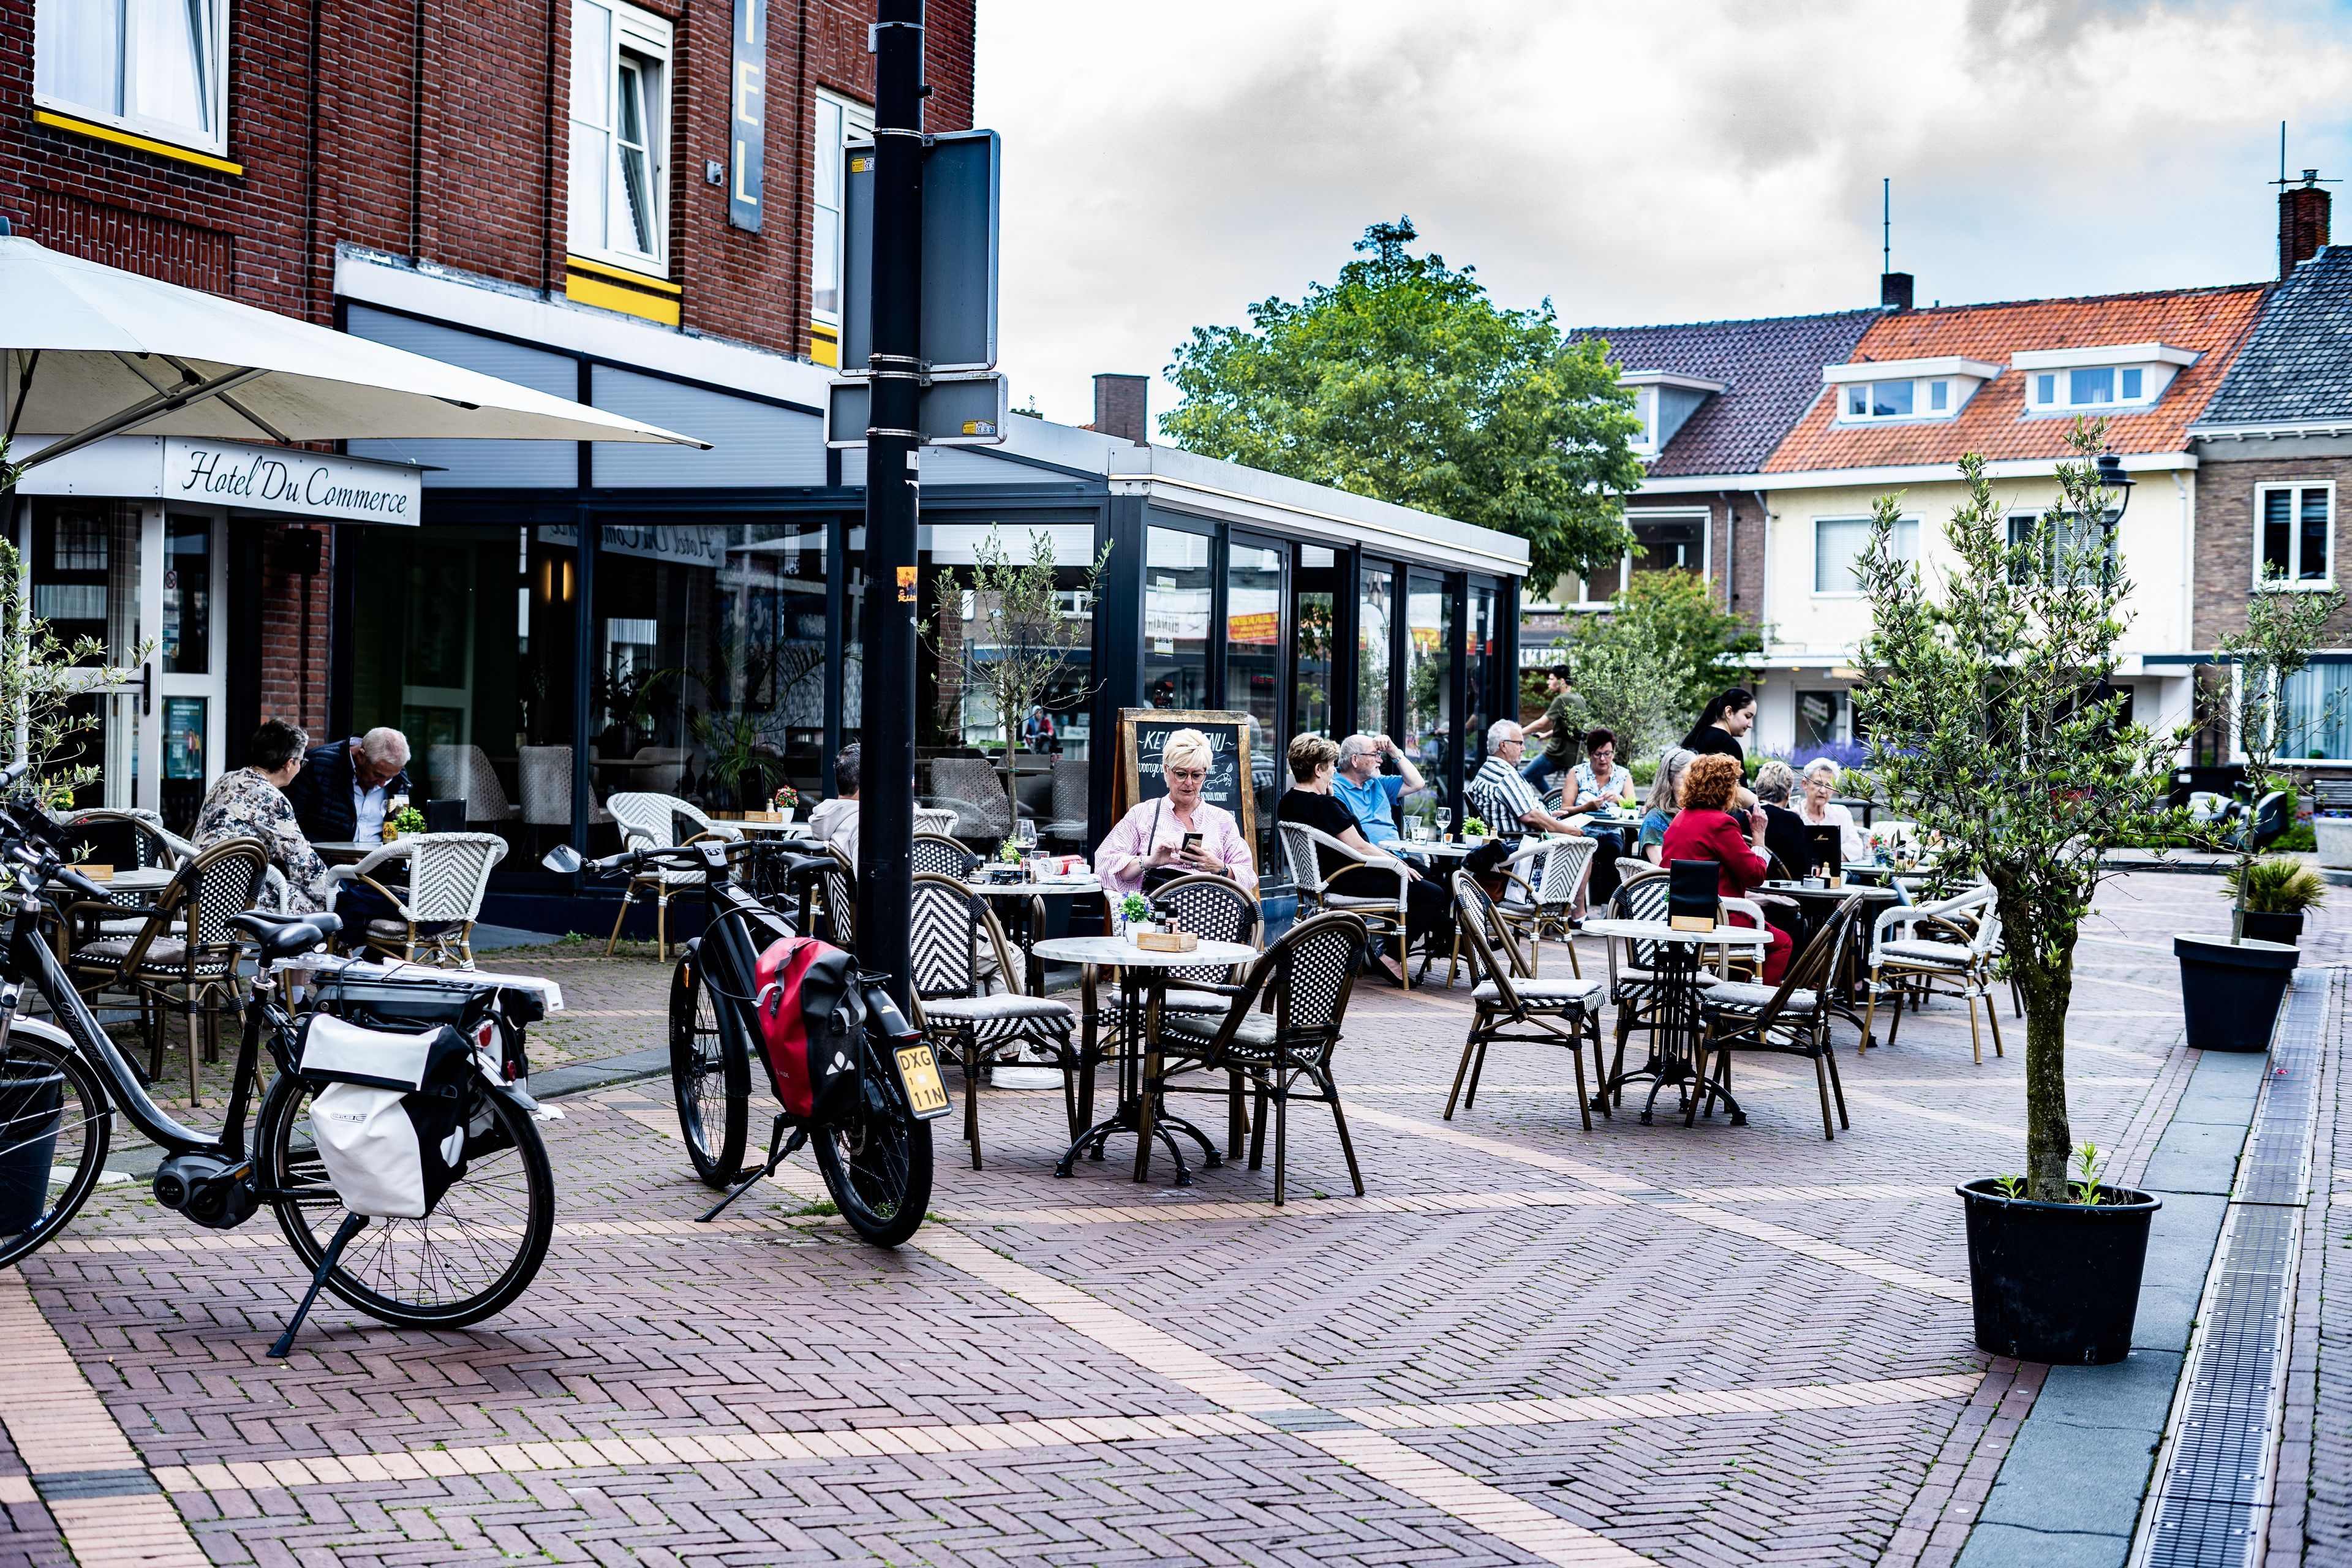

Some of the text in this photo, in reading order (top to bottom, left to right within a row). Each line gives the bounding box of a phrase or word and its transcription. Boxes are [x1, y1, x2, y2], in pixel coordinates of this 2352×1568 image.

[182, 451, 407, 513] Hotel Du Commerce
[60, 1001, 104, 1062] Diamant
[899, 1050, 932, 1071] DXG
[914, 1087, 944, 1107] 11N
